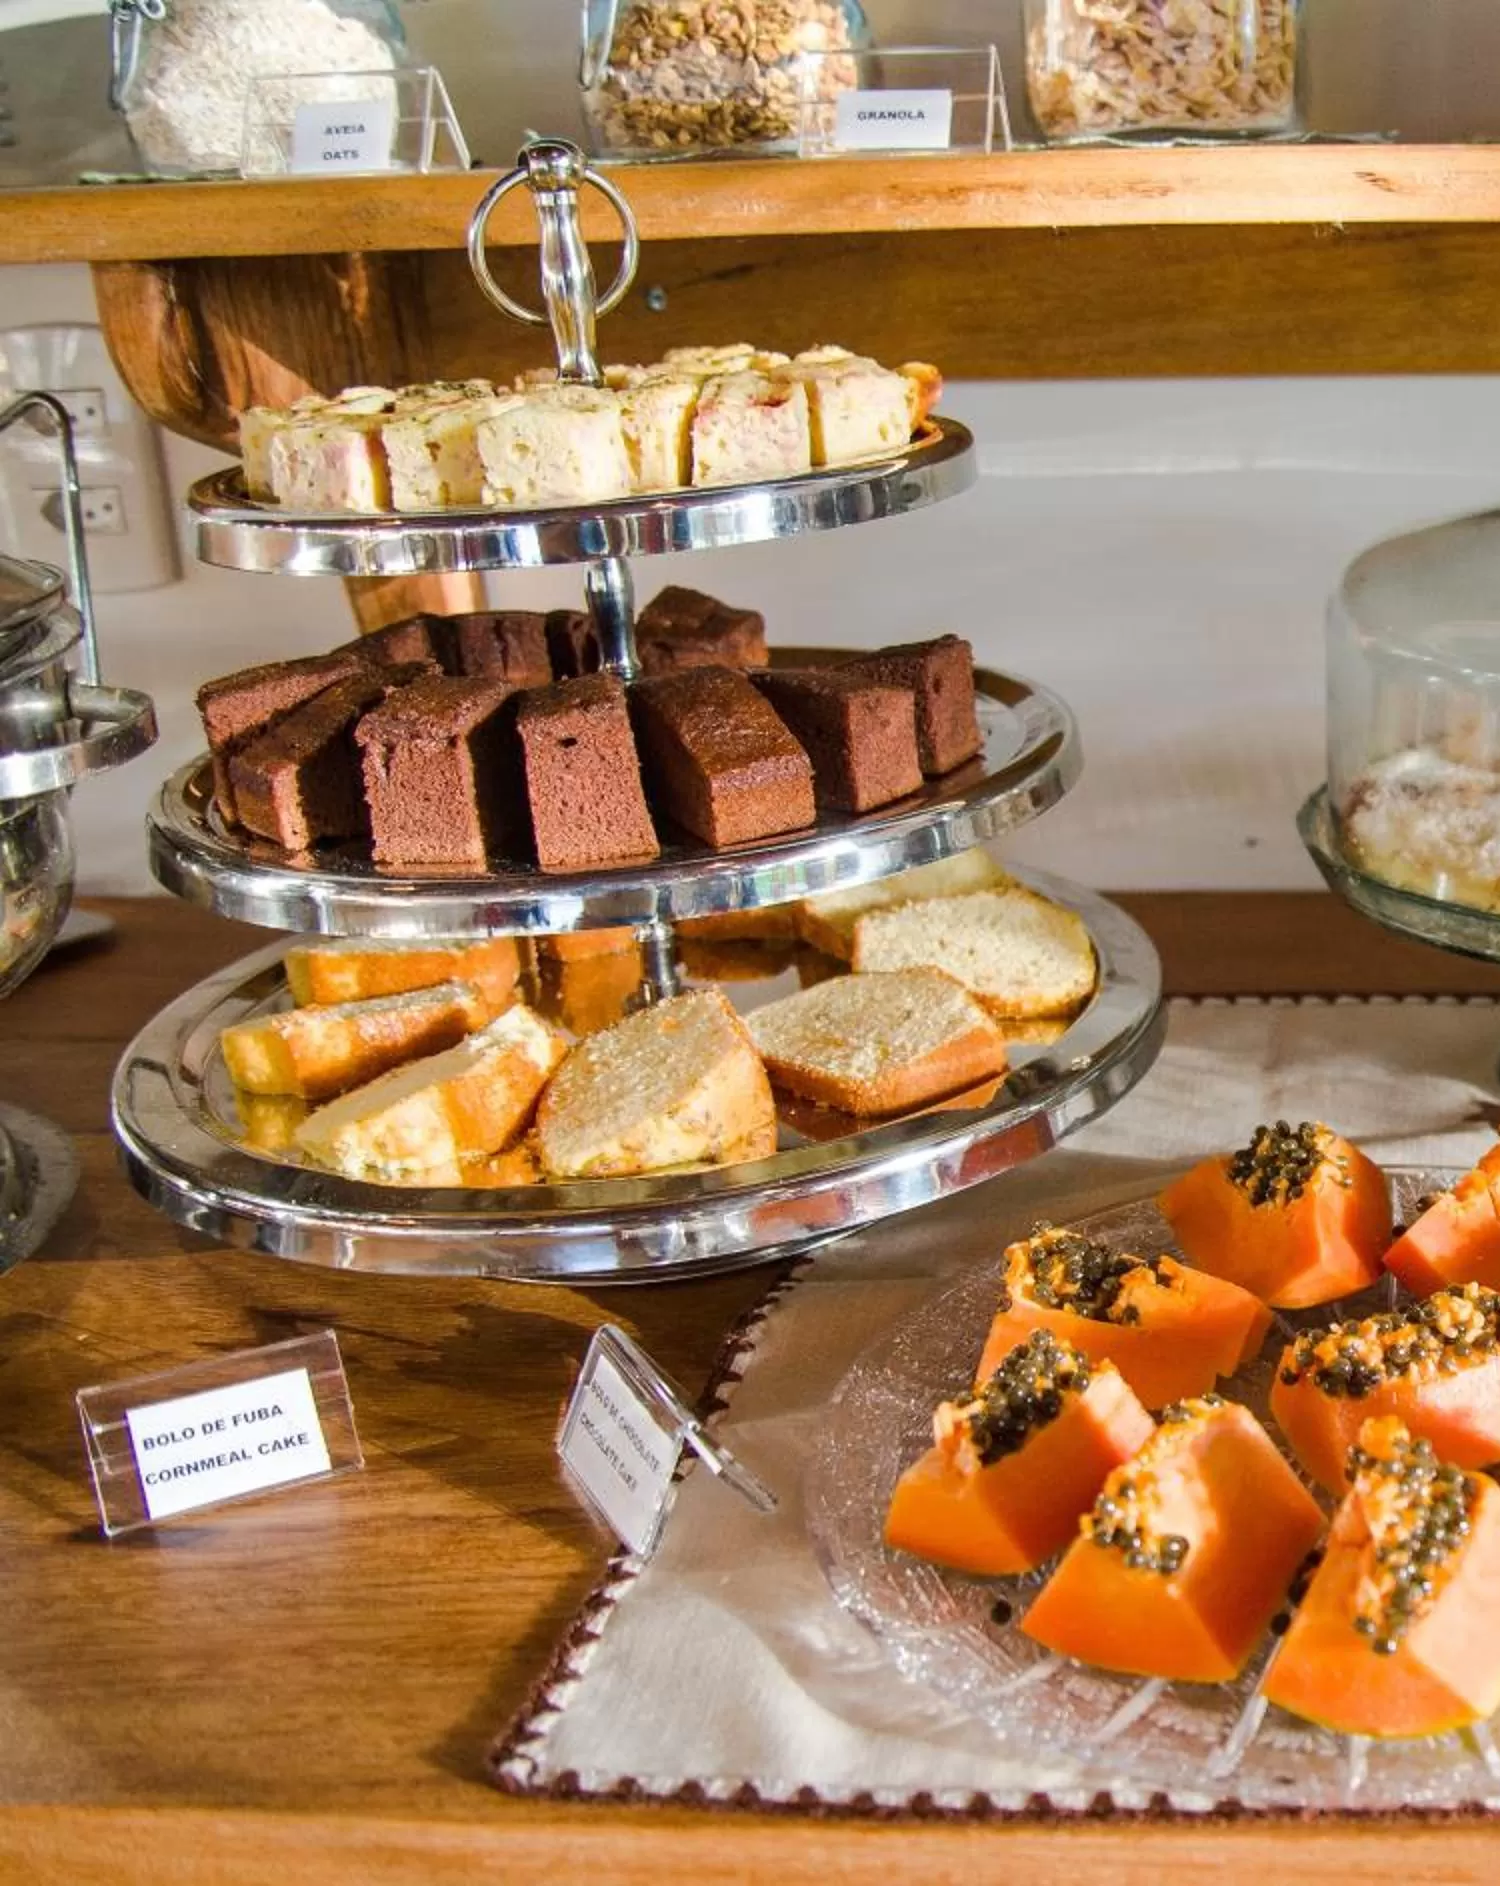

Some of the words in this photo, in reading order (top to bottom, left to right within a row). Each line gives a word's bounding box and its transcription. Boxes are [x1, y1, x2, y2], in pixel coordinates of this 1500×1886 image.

[857, 110, 925, 121] GRANOLA
[323, 124, 366, 136] AVEIA
[322, 150, 360, 161] OATS
[142, 1427, 195, 1451] BOLO
[201, 1419, 226, 1435] DE
[233, 1404, 283, 1427] FUBA
[145, 1448, 252, 1485] CORNMEAL
[257, 1432, 309, 1456] CAKE
